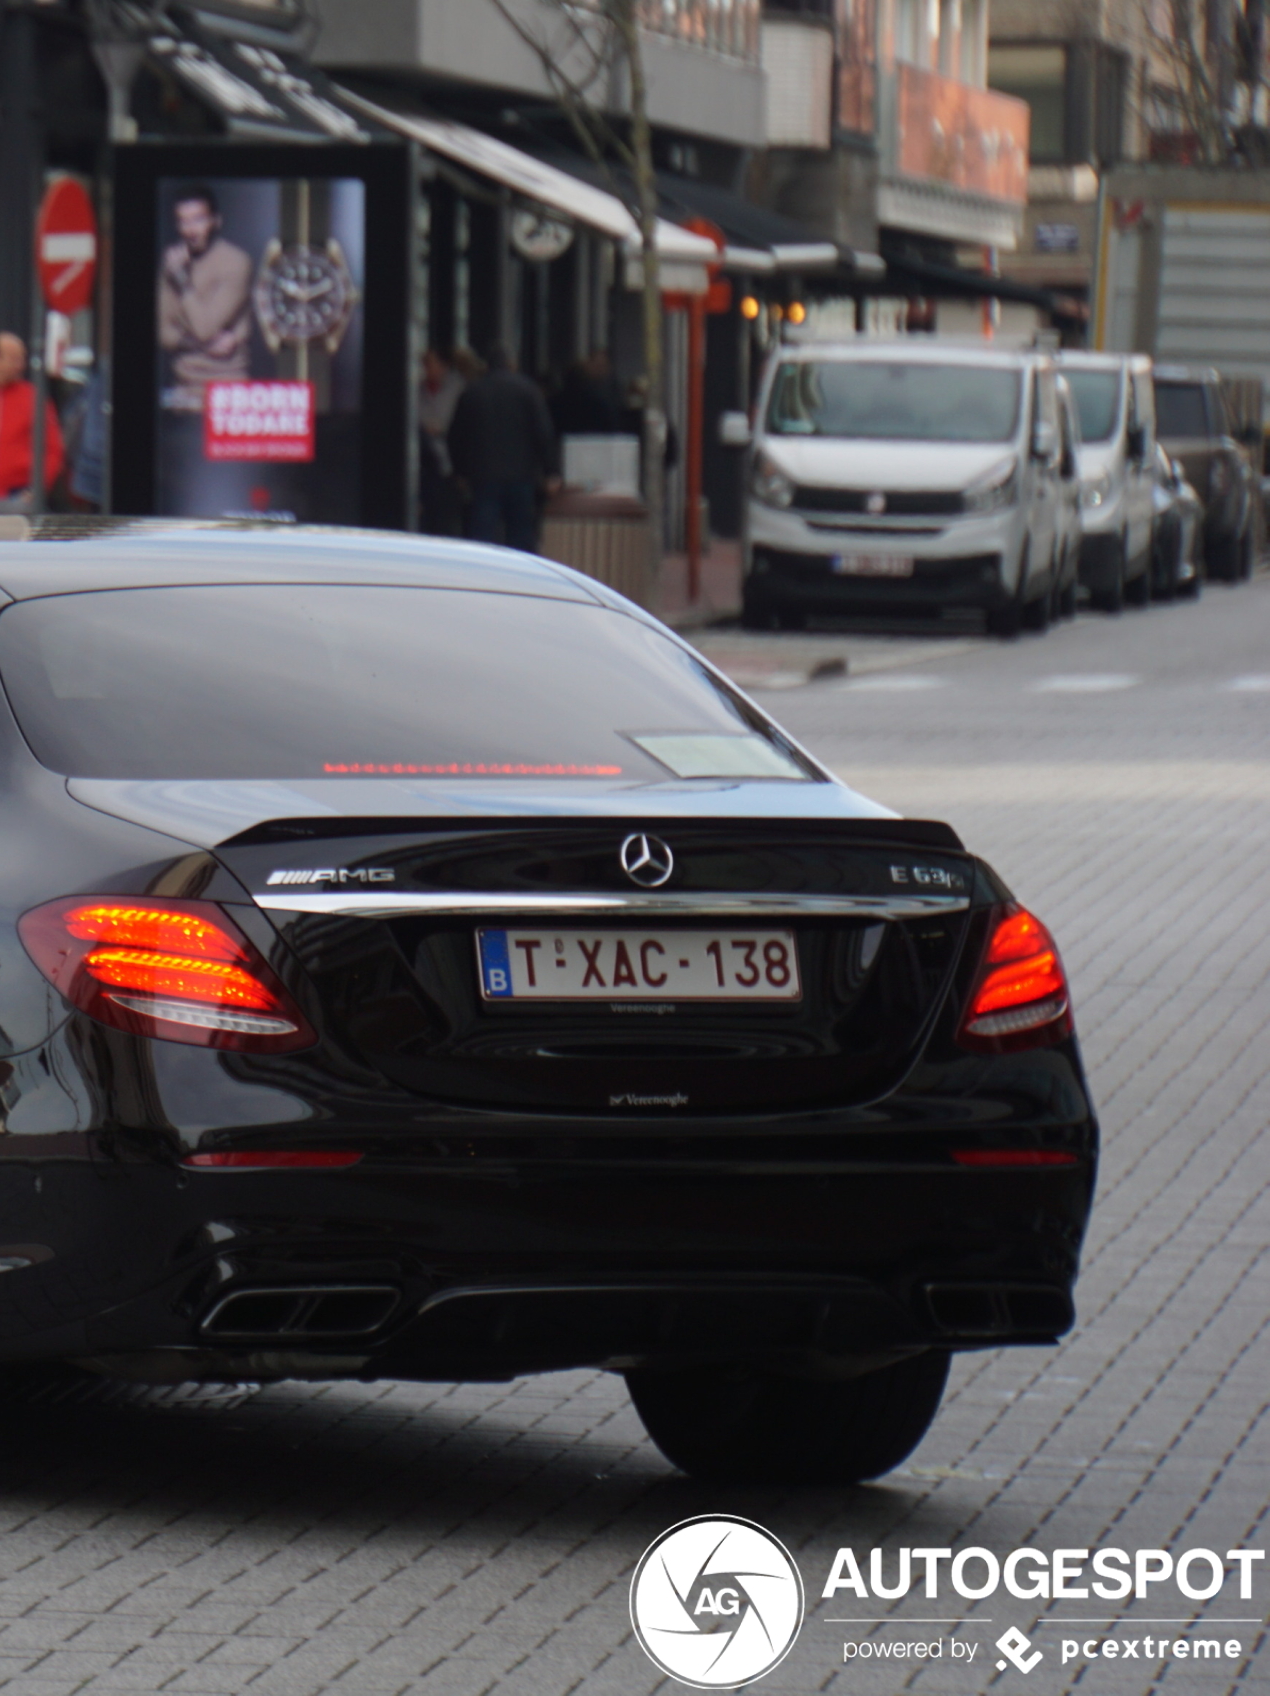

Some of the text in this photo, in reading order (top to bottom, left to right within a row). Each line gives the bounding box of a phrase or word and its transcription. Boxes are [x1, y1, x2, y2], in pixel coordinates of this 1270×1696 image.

[308, 867, 396, 884] AMG
[890, 865, 909, 883] E
[488, 969, 508, 991] B
